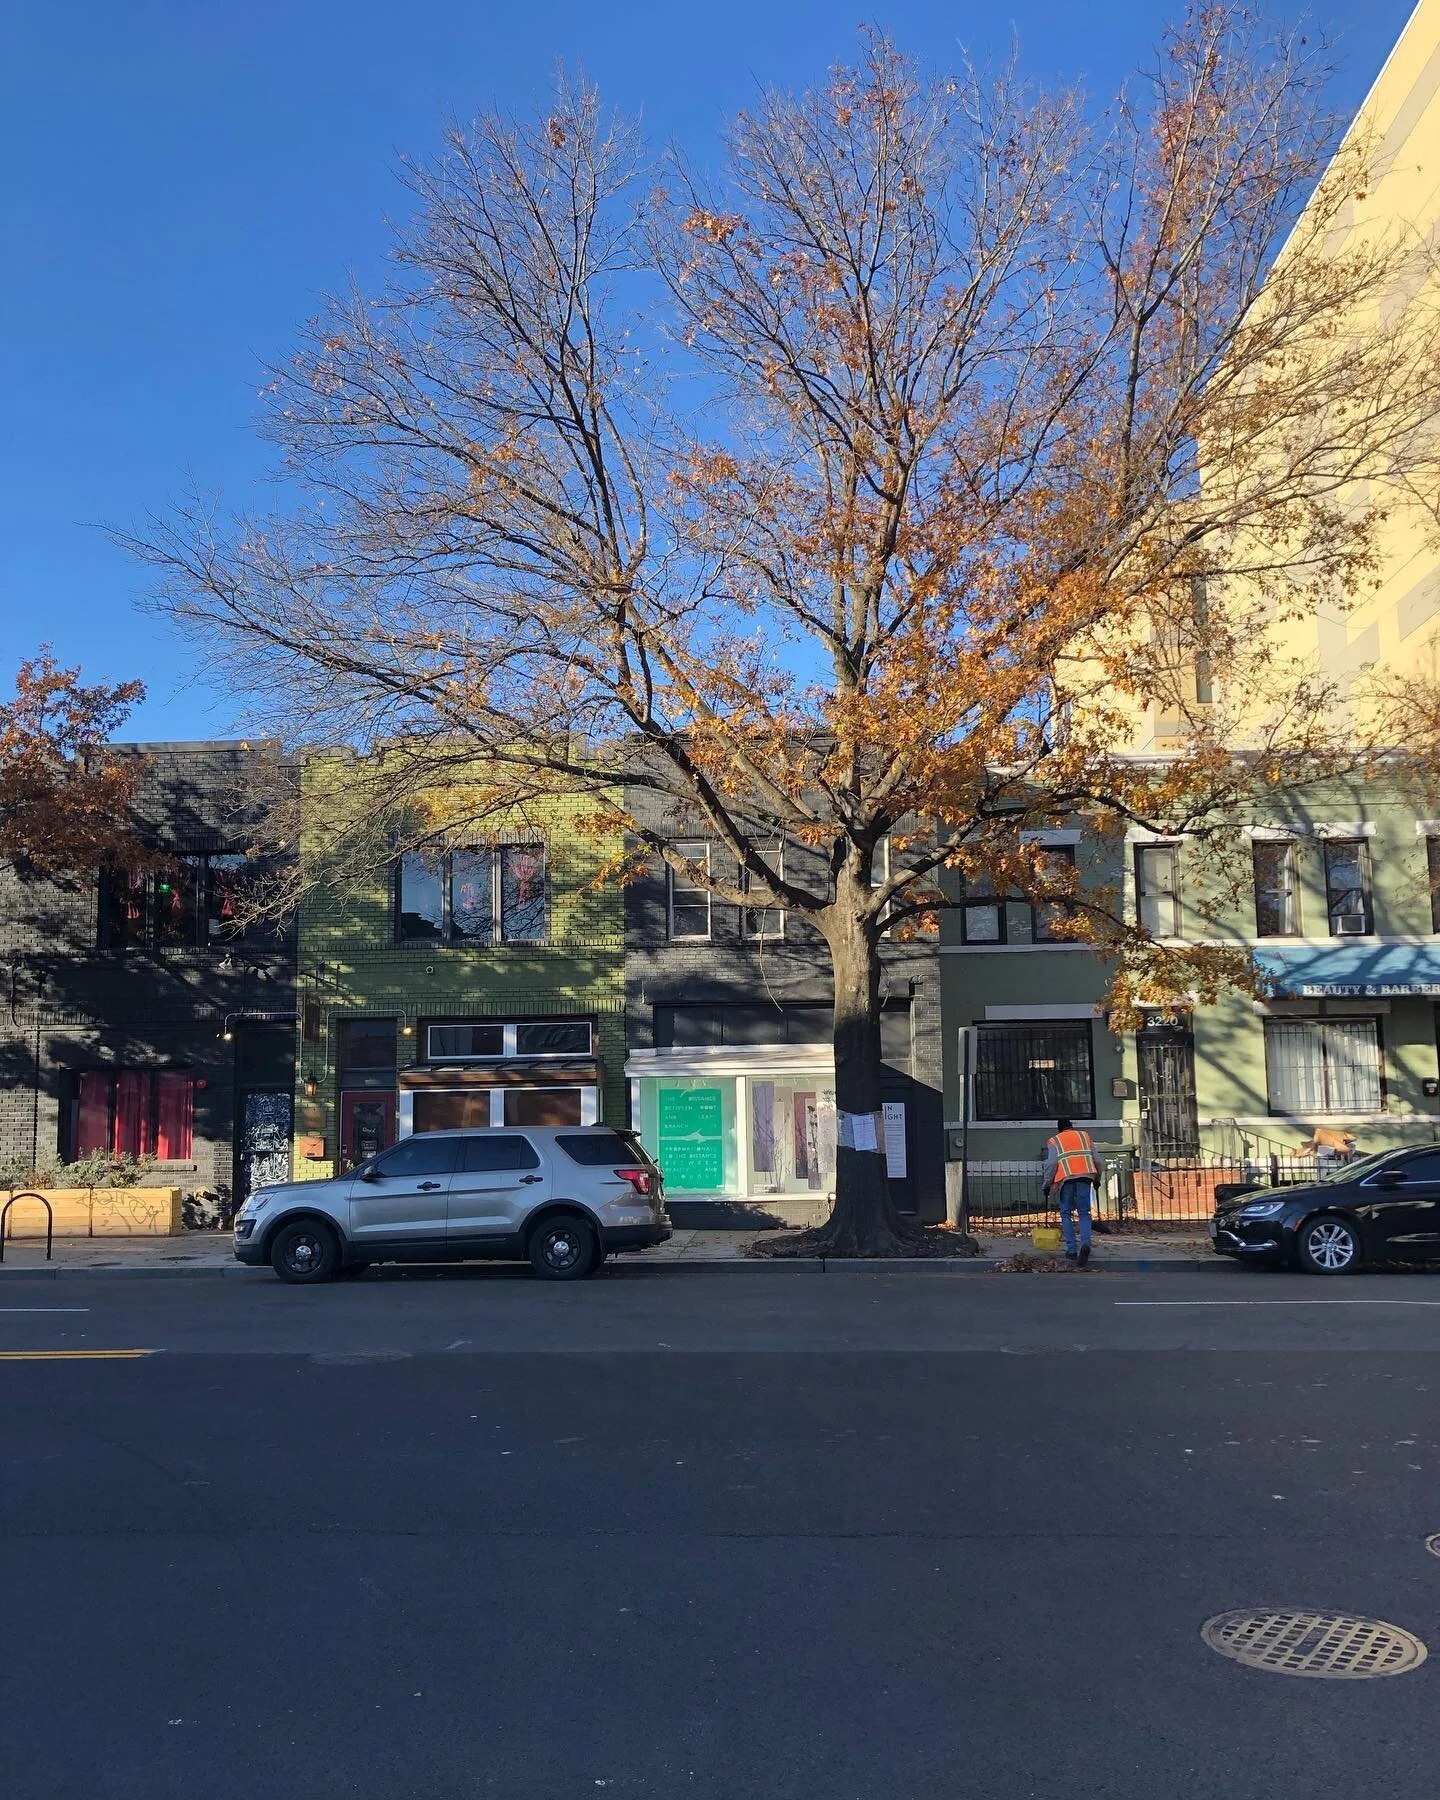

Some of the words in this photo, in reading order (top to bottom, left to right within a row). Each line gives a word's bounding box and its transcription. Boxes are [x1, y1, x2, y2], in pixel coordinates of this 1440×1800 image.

[1303, 985, 1361, 995] BEAUTY
[1365, 985, 1377, 995] &
[1381, 984, 1440, 995] BARBER
[1147, 1016, 1178, 1026] 3220
